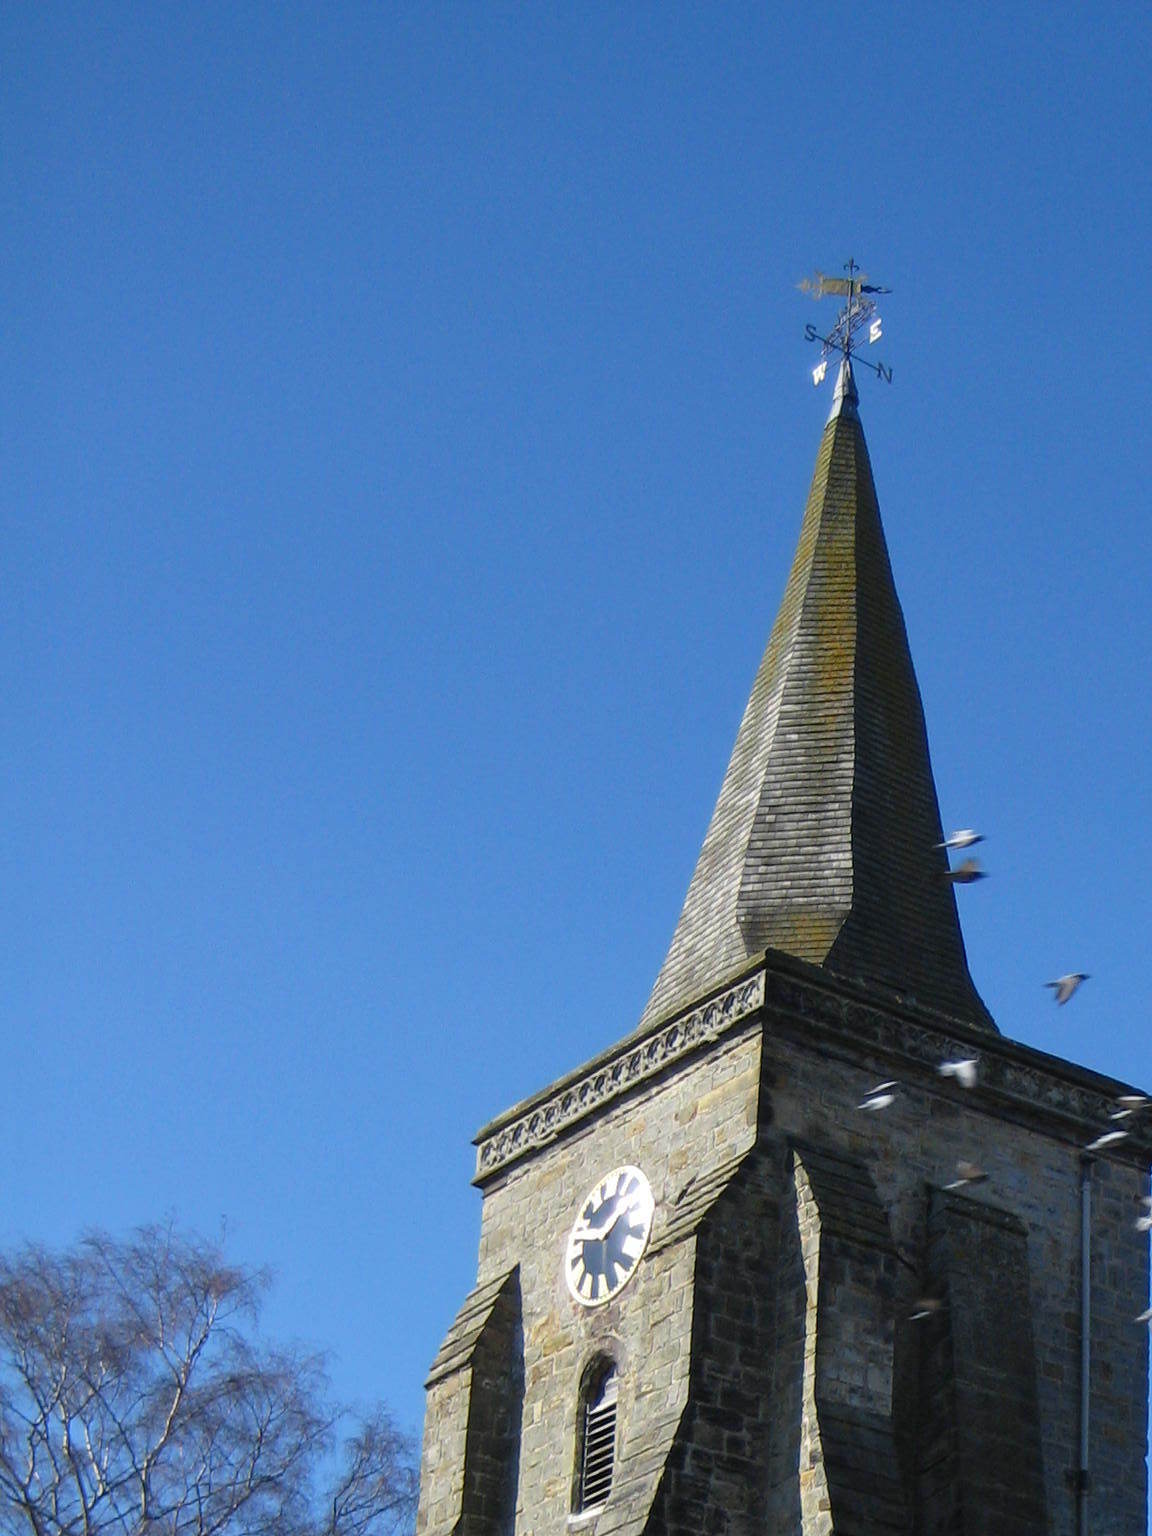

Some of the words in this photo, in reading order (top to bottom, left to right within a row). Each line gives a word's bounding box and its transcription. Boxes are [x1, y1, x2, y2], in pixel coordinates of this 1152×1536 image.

[804, 324, 817, 342] S
[869, 318, 883, 344] E
[877, 362, 893, 384] N
